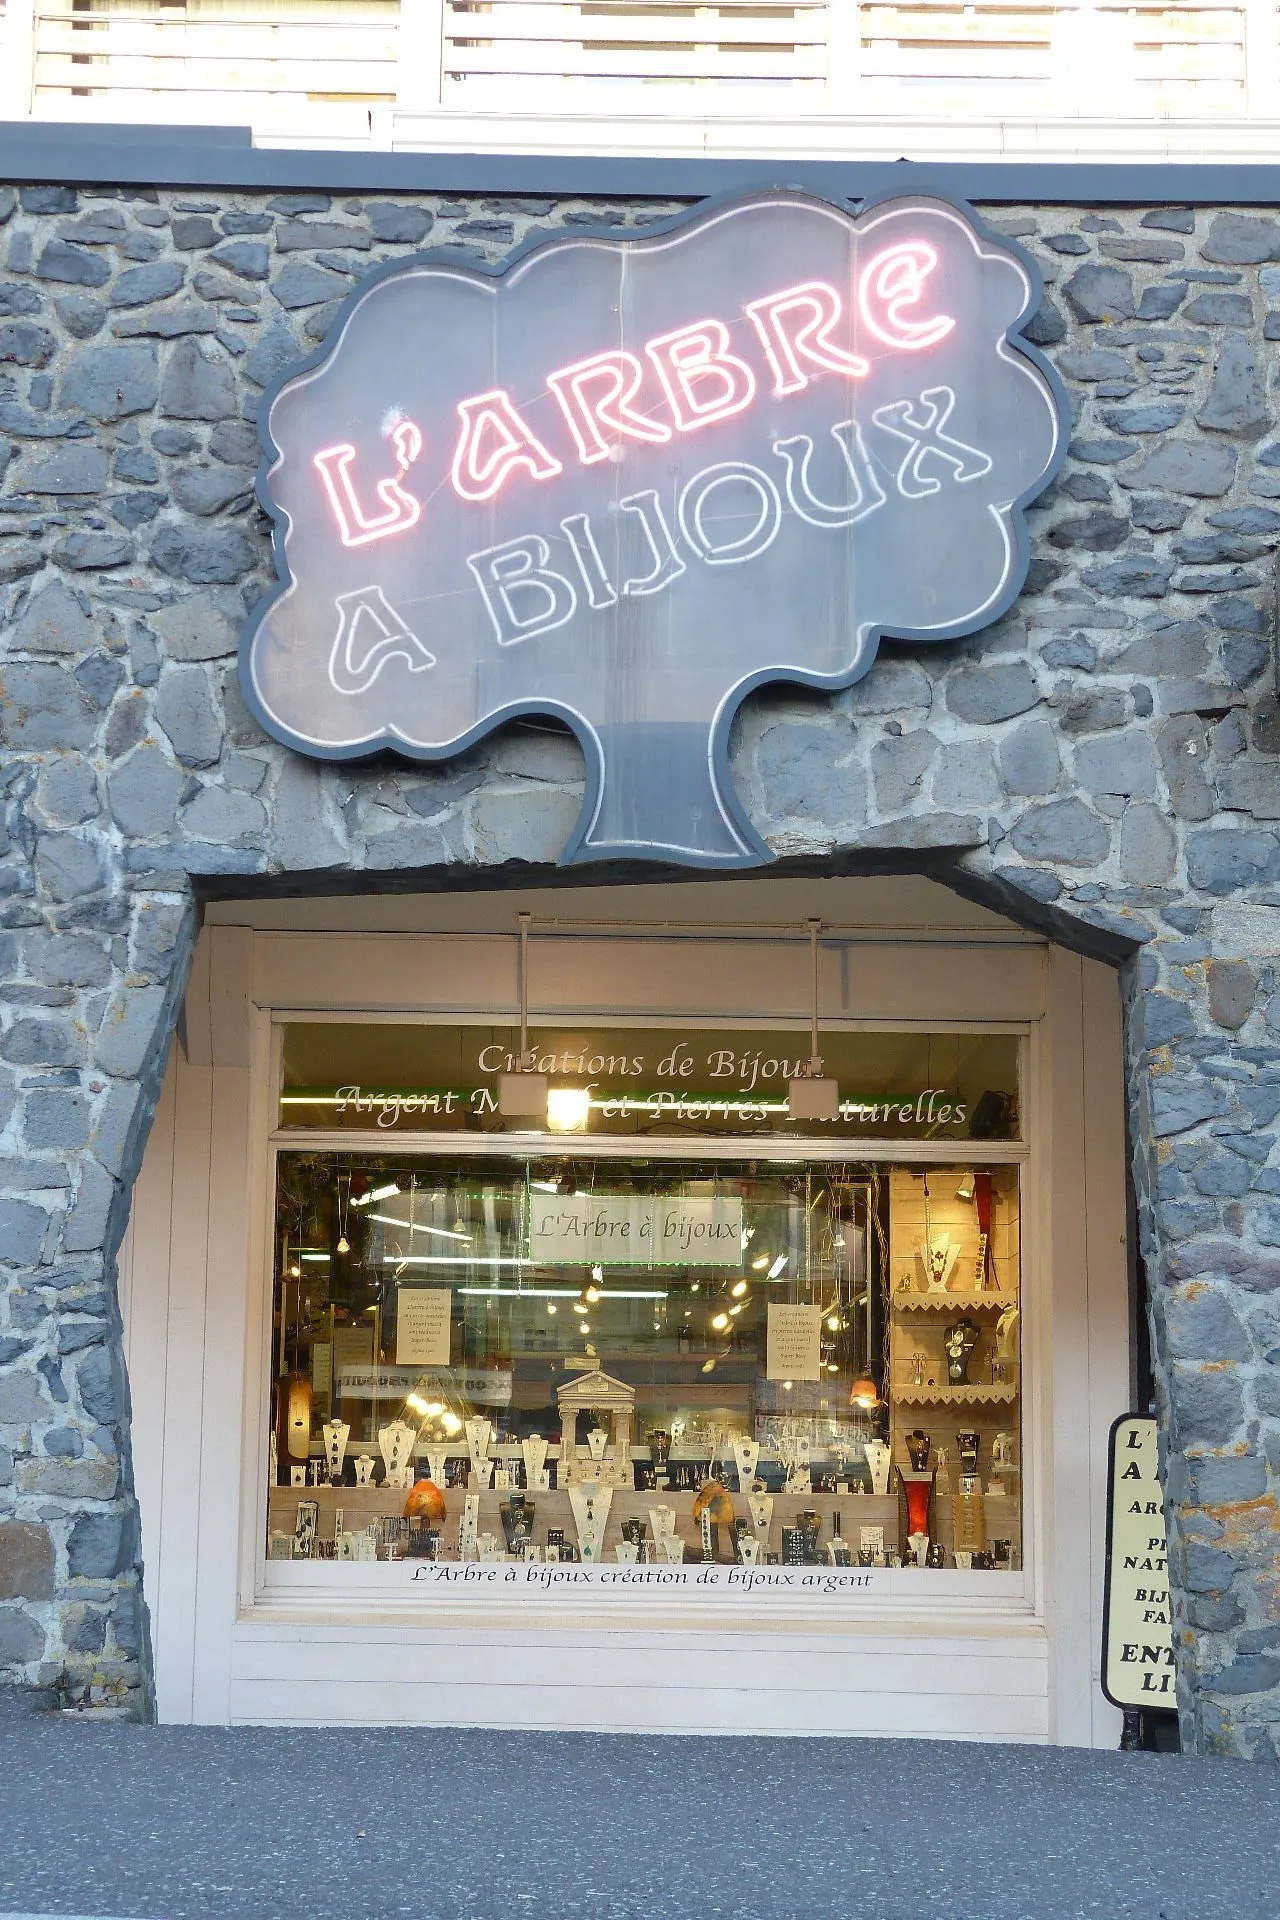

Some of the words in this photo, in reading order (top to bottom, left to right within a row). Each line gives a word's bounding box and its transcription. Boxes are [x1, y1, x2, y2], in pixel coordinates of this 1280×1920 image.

[329, 585, 437, 695] A
[466, 385, 993, 648] BIJOUX
[478, 1045, 644, 1076] Créations
[656, 1042, 695, 1077] de
[334, 1085, 460, 1128] Argent
[602, 1095, 636, 1119] et
[647, 1091, 769, 1121] Pierres
[783, 1089, 967, 1124] turelles
[535, 1210, 631, 1238] L'Arbre
[639, 1215, 653, 1239] à
[663, 1210, 738, 1250] bijoux
[1125, 1430, 1159, 1450] L'
[1120, 1461, 1142, 1480] A
[1146, 1538, 1168, 1551] PI
[410, 1563, 497, 1582] L'Arbre
[504, 1567, 518, 1582] à
[526, 1564, 594, 1589] bijoux
[600, 1567, 689, 1584] création
[696, 1566, 720, 1585] de
[727, 1566, 796, 1592] bijoux
[801, 1573, 874, 1593] argent
[1142, 1610, 1172, 1625] FA
[1140, 1672, 1176, 1693] LI
